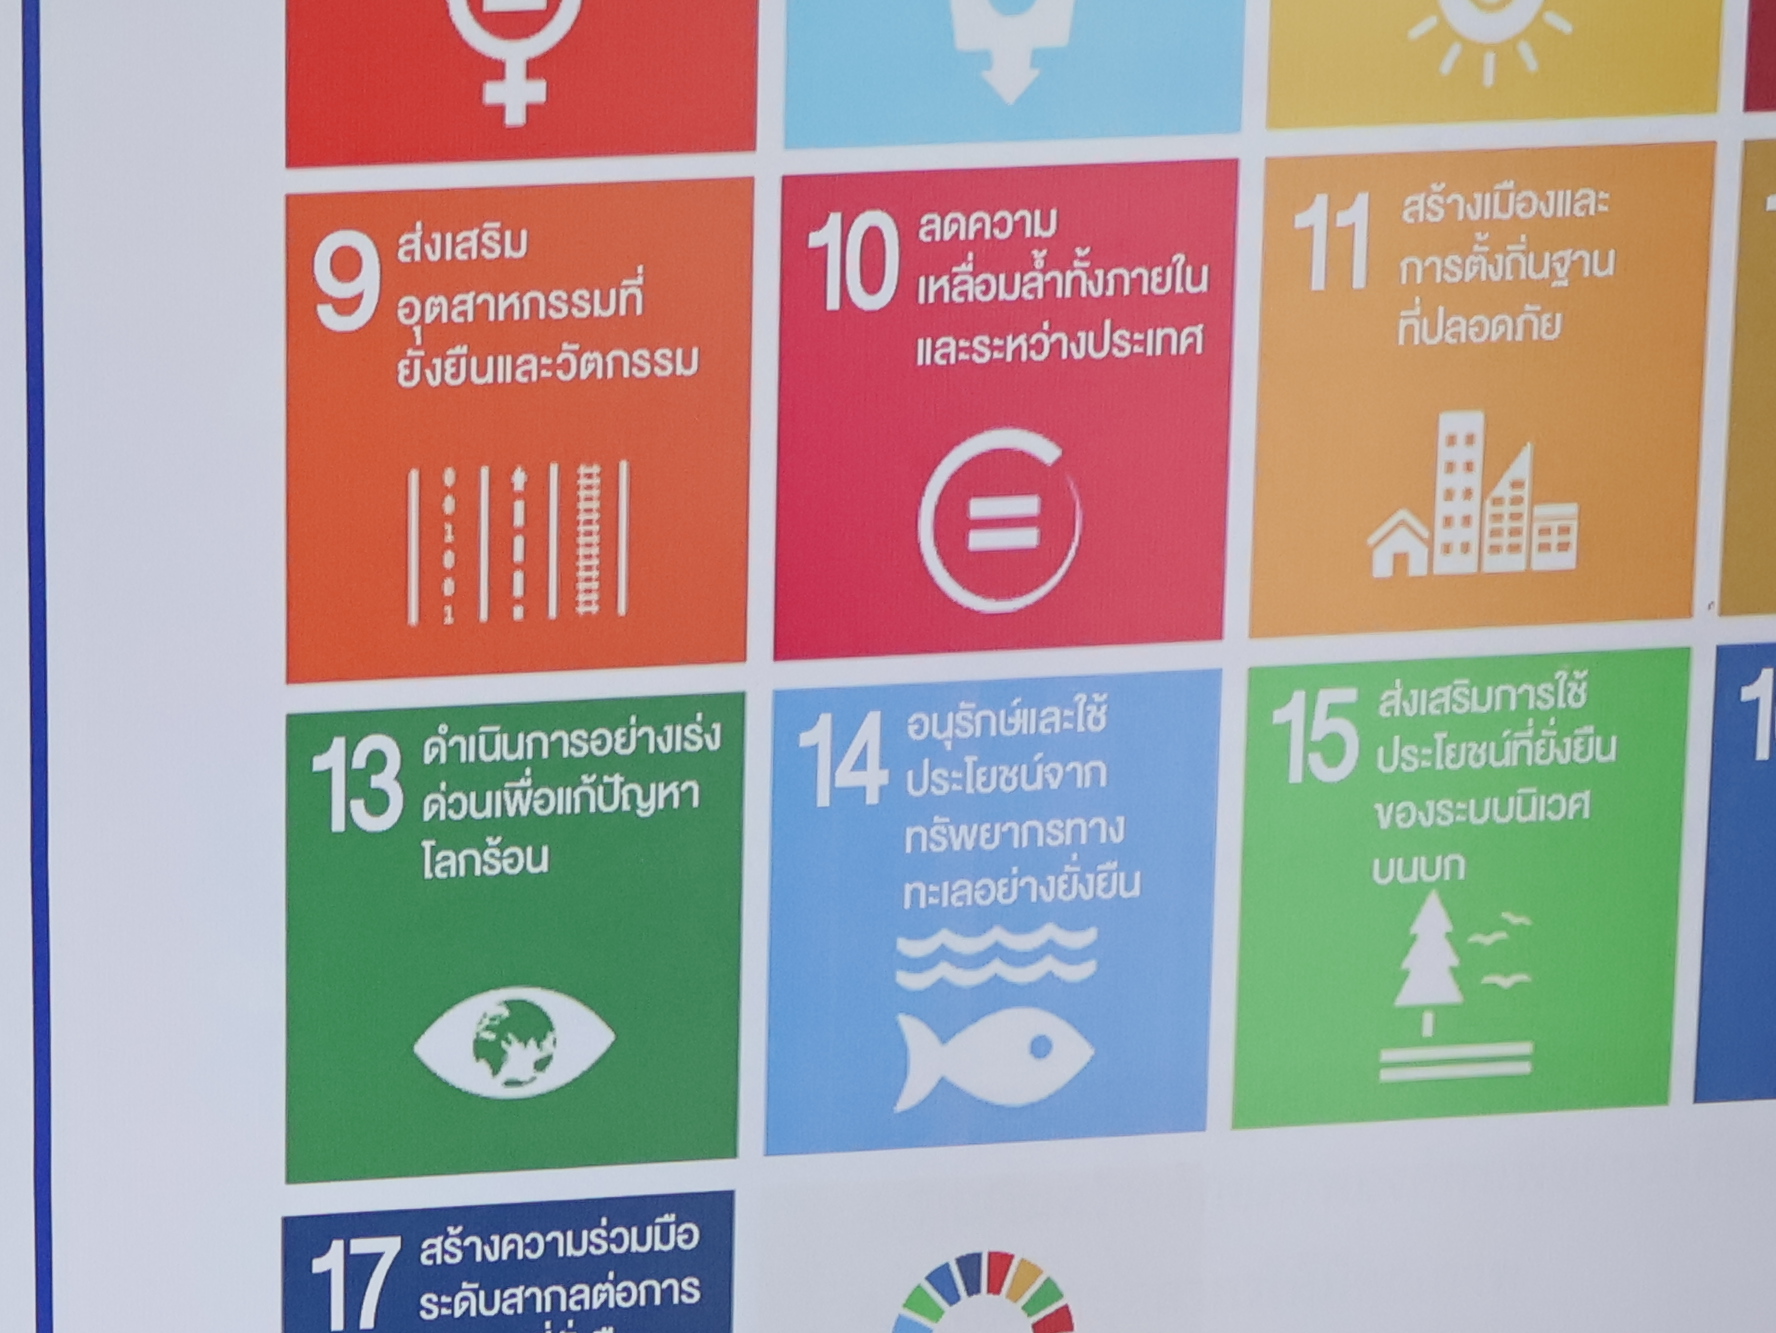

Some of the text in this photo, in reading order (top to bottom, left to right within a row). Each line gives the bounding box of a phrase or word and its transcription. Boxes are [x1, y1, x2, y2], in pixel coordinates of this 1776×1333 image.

[919, 208, 1057, 242] ลดความ
[1402, 179, 1610, 223] สร้างเมืองและ
[397, 221, 528, 263] ส่งเสริม
[808, 209, 900, 311] 10
[1294, 192, 1370, 291] 11
[1400, 232, 1615, 288] การตั้งถิ่นฐาน
[313, 229, 382, 333] 9
[397, 265, 645, 335] อุตสาหกรรมที่
[918, 246, 1209, 304] เหลื่อมล้ำทั้งภายใน
[917, 319, 1204, 366] และระหว่างประเทศ
[1398, 296, 1563, 346] ที่ปลอดภัย
[1379, 669, 1588, 717] ส่งเสริมการใช้
[422, 713, 721, 765] ดำเนินการอย่างเร่ง
[907, 692, 1108, 750] อนุรักษ์และใช้
[1272, 687, 1359, 784] 15
[1377, 717, 1617, 773] ประโยชน์ที่ยั่งยืน
[312, 733, 403, 833] 13
[799, 711, 889, 807] 14
[907, 753, 1107, 796] ประโยชน์จาก
[422, 768, 700, 822] ด่วนเพื่อแก้ปัญหา
[1374, 787, 1591, 830] ของระบบนิเวศ
[421, 836, 549, 880] โลกร้อน
[905, 816, 1126, 854] ทรัพยากรทาง
[903, 853, 1141, 910] ทะเลอย่างยั่งยืน
[1372, 853, 1466, 885] บนบก
[420, 1213, 700, 1266] สร้างความร่วมมือ
[311, 1235, 402, 1332] 17
[419, 1271, 701, 1321] ระดับสากลต่อการ
